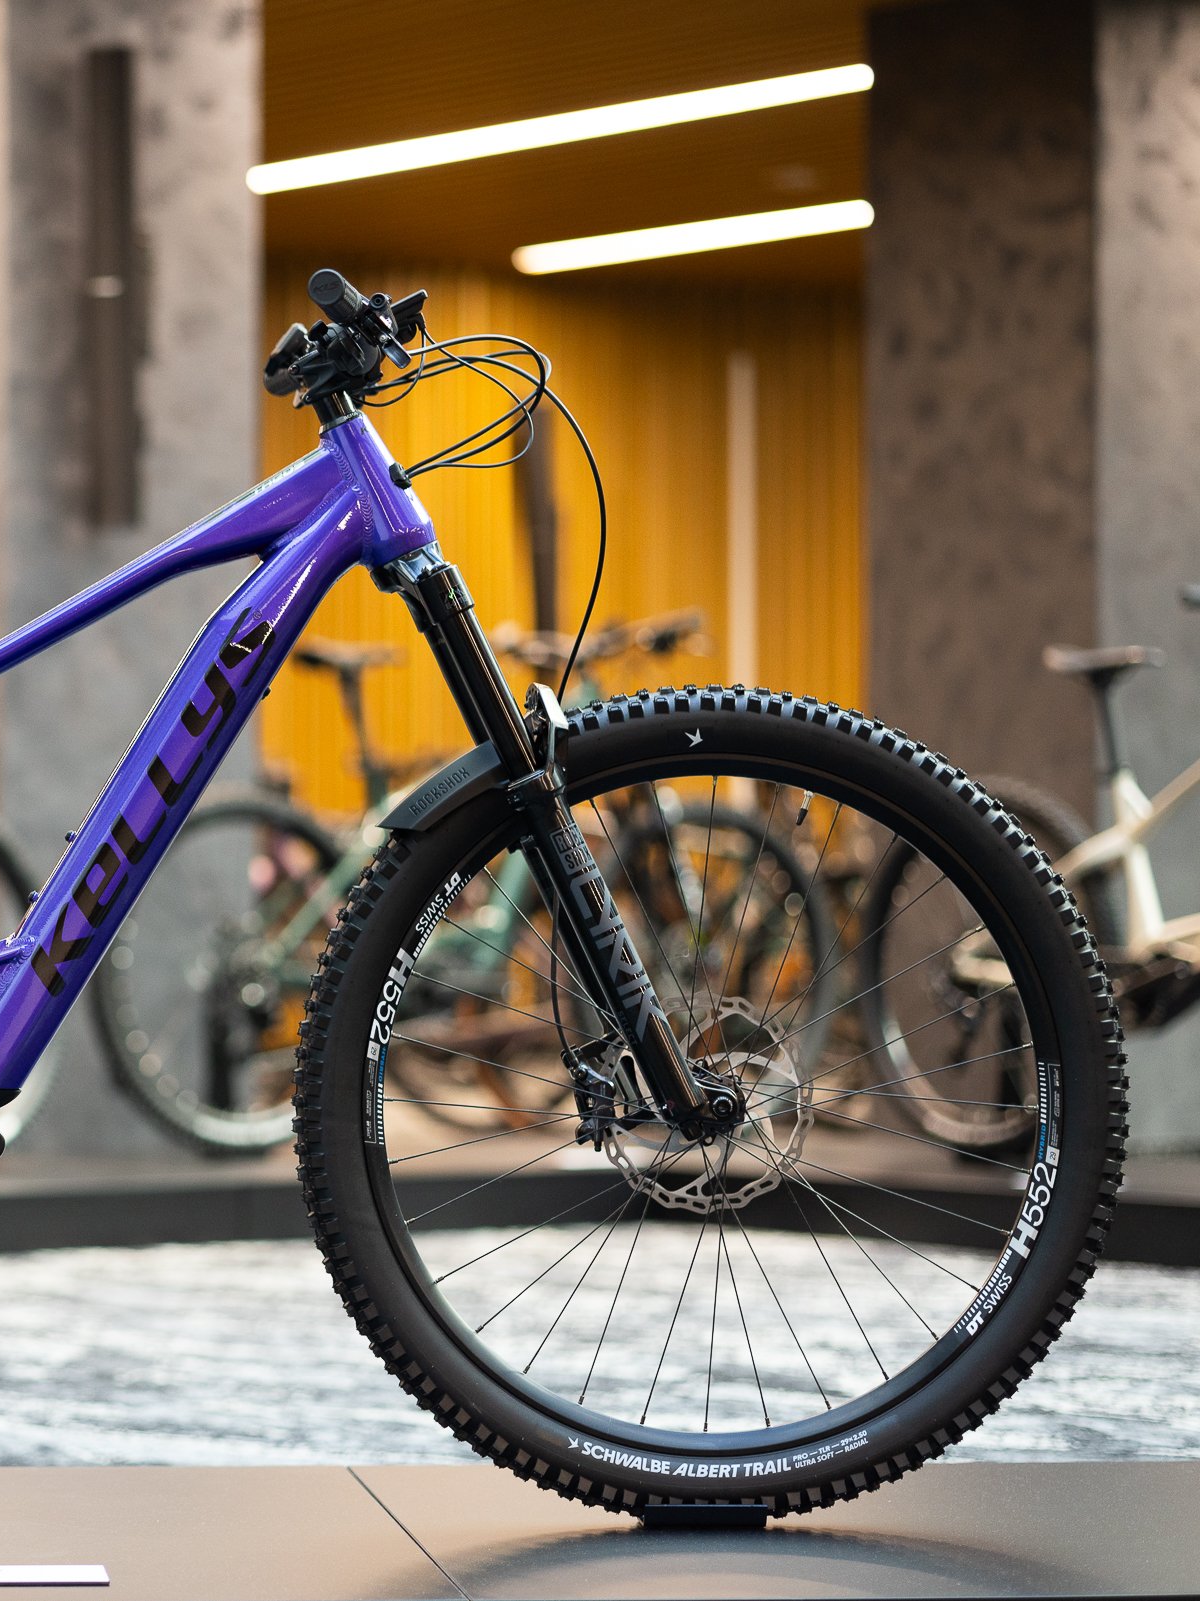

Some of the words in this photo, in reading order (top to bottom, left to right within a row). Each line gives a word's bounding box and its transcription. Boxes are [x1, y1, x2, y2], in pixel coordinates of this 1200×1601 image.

[409, 767, 470, 816] ROCKSHOX
[443, 871, 462, 897] DT
[415, 893, 445, 934] SWISS
[570, 868, 669, 1043] LYRIK
[369, 947, 416, 1044] H552
[1009, 1162, 1057, 1259] H552
[965, 1310, 985, 1336] DT
[982, 1272, 1013, 1314] SWISS
[581, 1441, 670, 1475] SCHWALBE
[672, 1462, 740, 1478] ALBERT
[744, 1457, 791, 1477] TRAIL
[792, 1452, 808, 1462] PRO
[818, 1445, 831, 1455] TLR
[795, 1457, 817, 1469] ULTRA
[817, 1451, 834, 1463] SOFT
[844, 1437, 869, 1453] RADIAL
